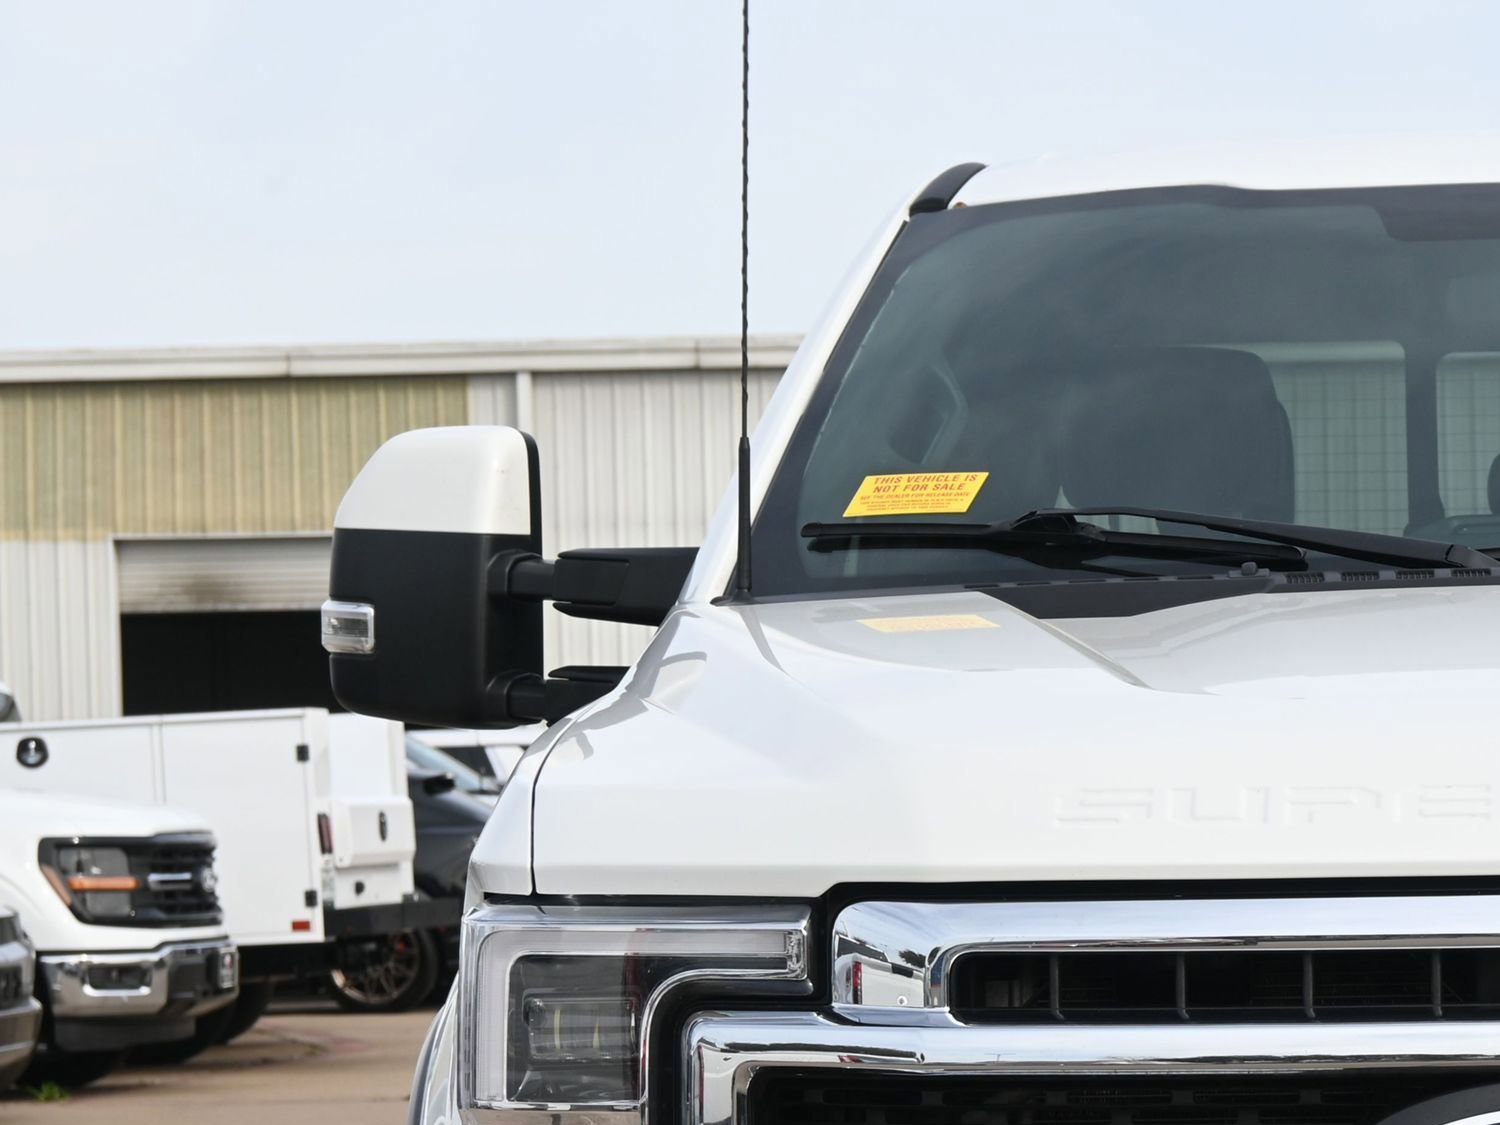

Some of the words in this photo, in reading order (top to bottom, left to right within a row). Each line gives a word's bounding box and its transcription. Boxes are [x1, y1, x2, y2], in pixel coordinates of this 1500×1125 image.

[873, 476, 901, 485] THIS
[906, 475, 960, 483] VEHICLE
[965, 474, 978, 482] IS
[873, 485, 900, 493] NOT
[903, 484, 928, 492] FOR
[932, 483, 966, 491] SALE
